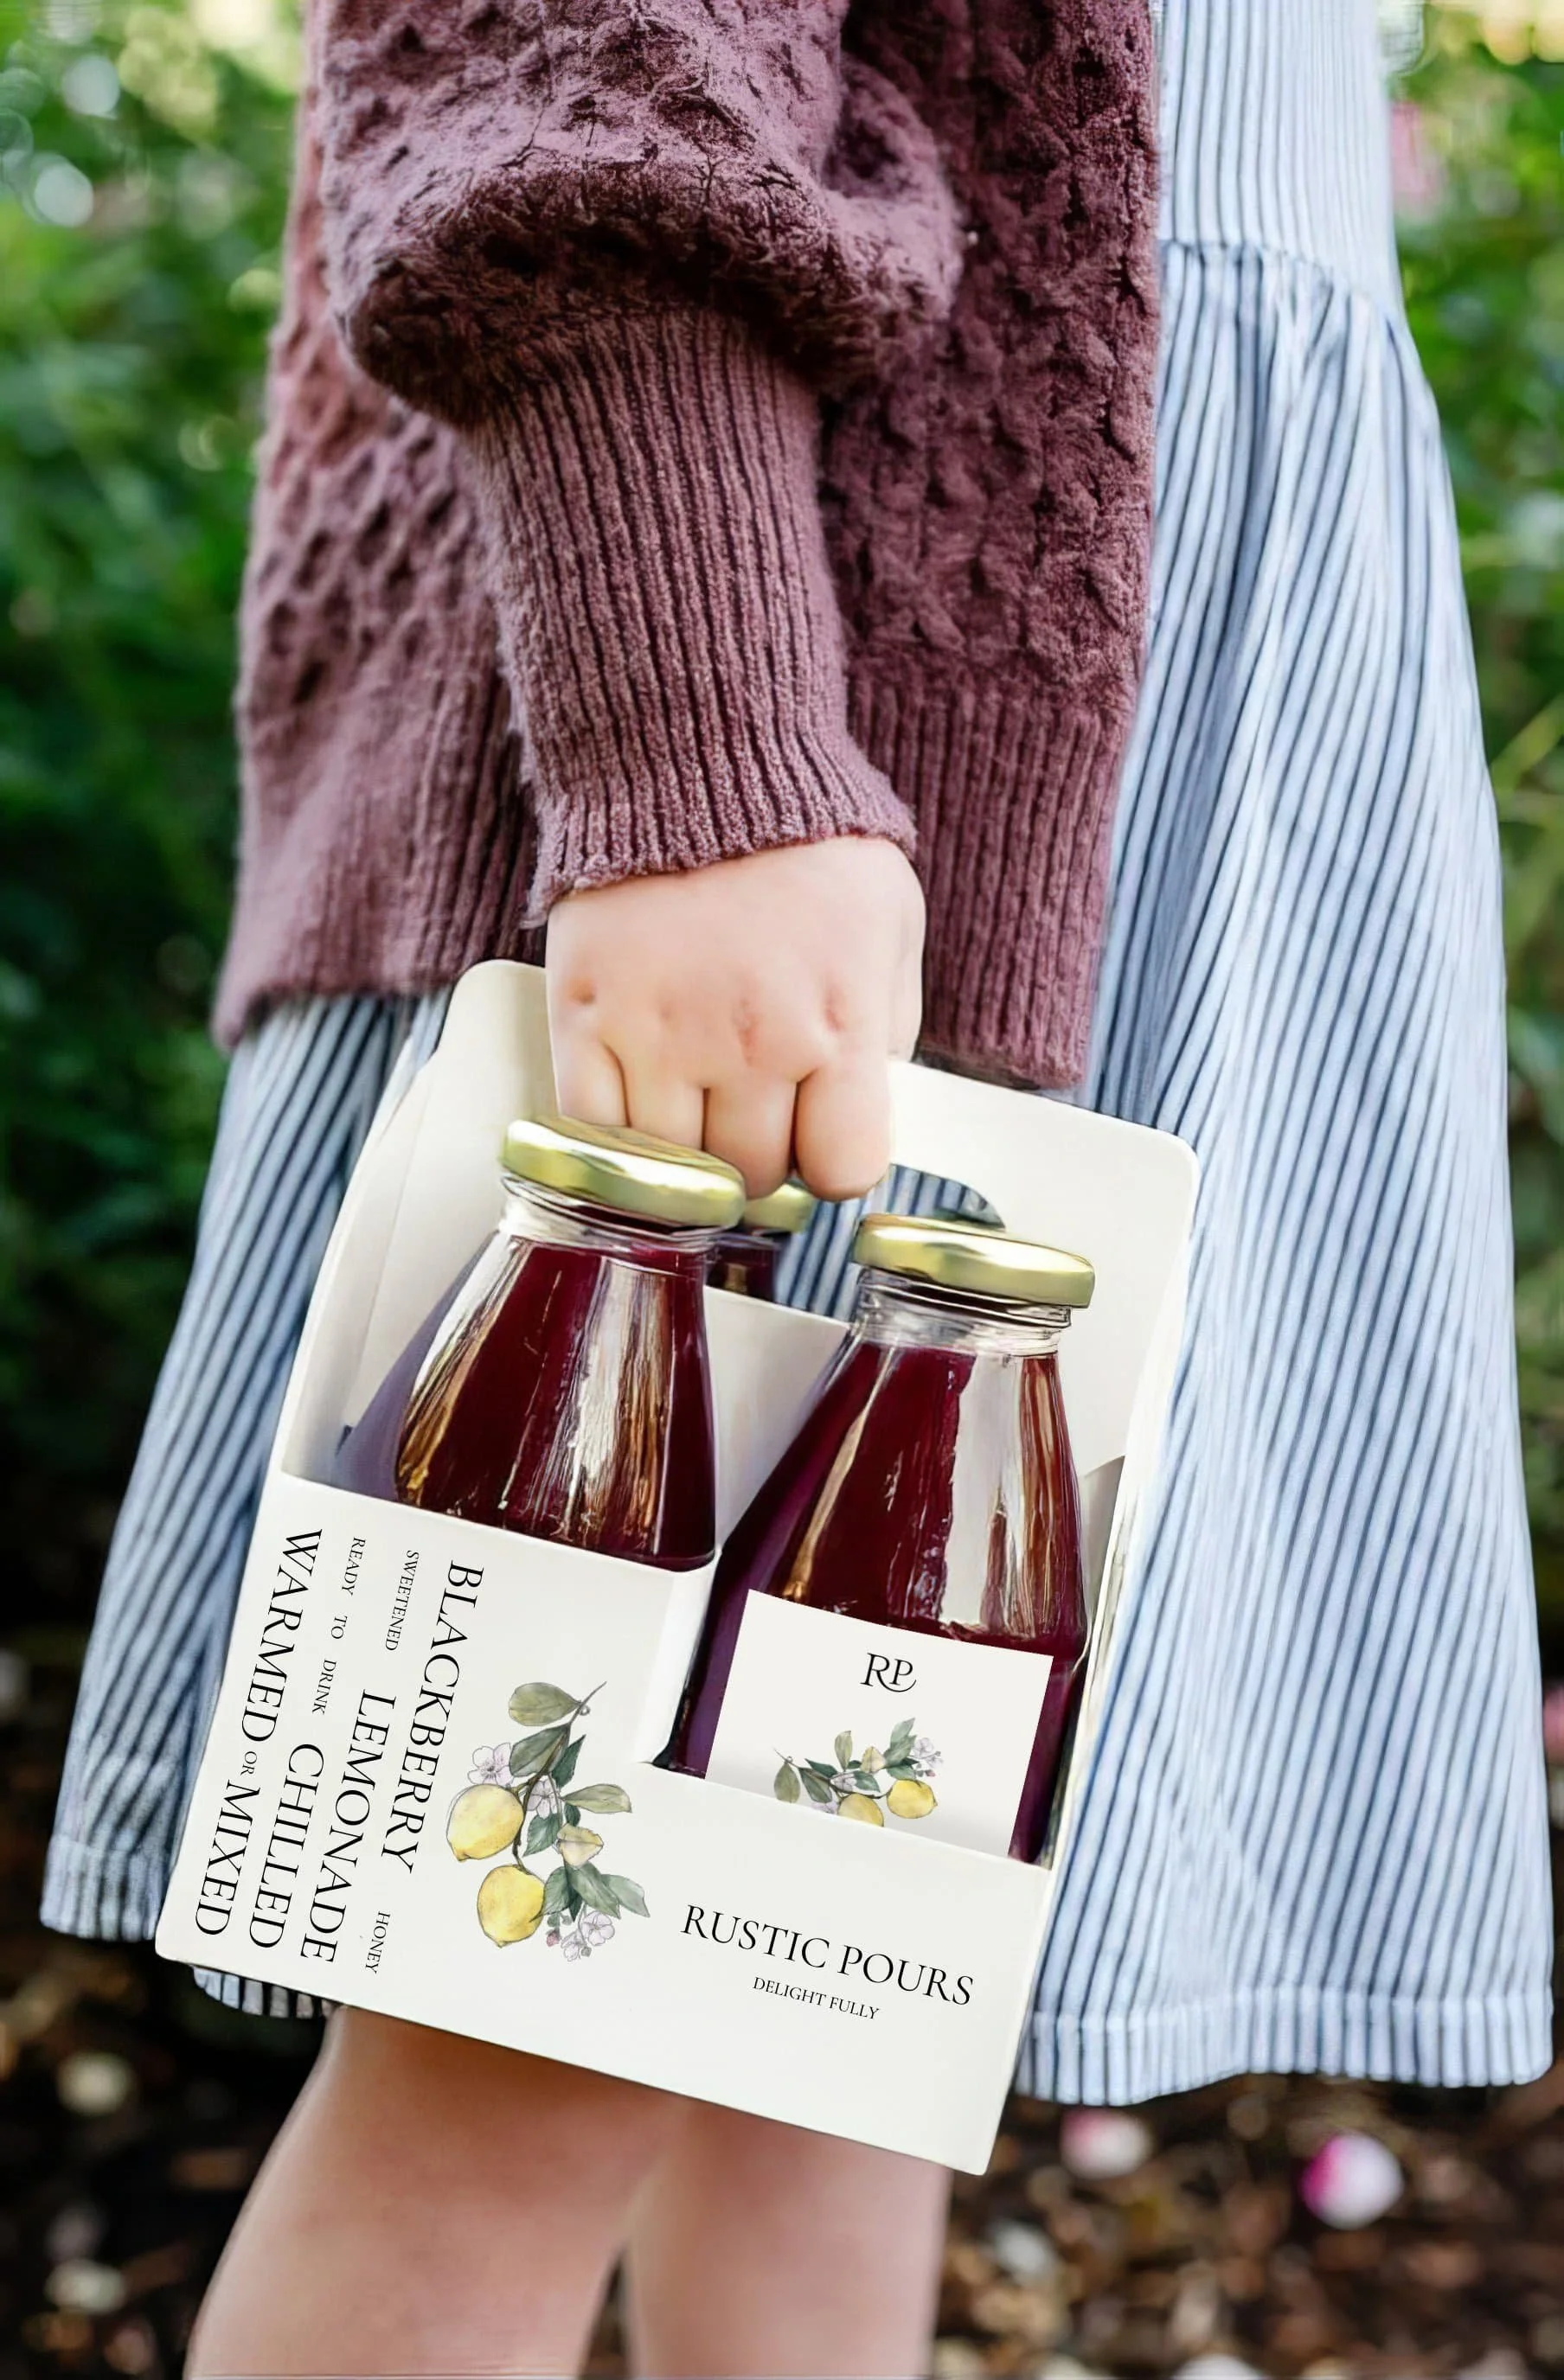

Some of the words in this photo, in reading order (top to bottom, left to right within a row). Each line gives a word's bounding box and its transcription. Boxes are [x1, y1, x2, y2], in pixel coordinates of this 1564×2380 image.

[340, 1537, 367, 1596] READY
[385, 1551, 420, 1651] SWEETENED
[241, 1529, 323, 1742] WARMED
[330, 1615, 348, 1640] TO
[311, 1659, 337, 1715] DRINK
[380, 1559, 484, 1874] BLACKBERRY
[240, 1750, 258, 1775] OR
[195, 1779, 261, 1936] MIXED
[248, 1743, 324, 1948] CHILLED
[299, 1689, 397, 1963] LEMONADE
[364, 1910, 391, 1975] HONEY
[680, 1904, 830, 1968] RUSTIC
[836, 1944, 974, 2006] POURS
[752, 1976, 826, 2006] DELIGHT
[828, 1996, 880, 2020] FULLY
